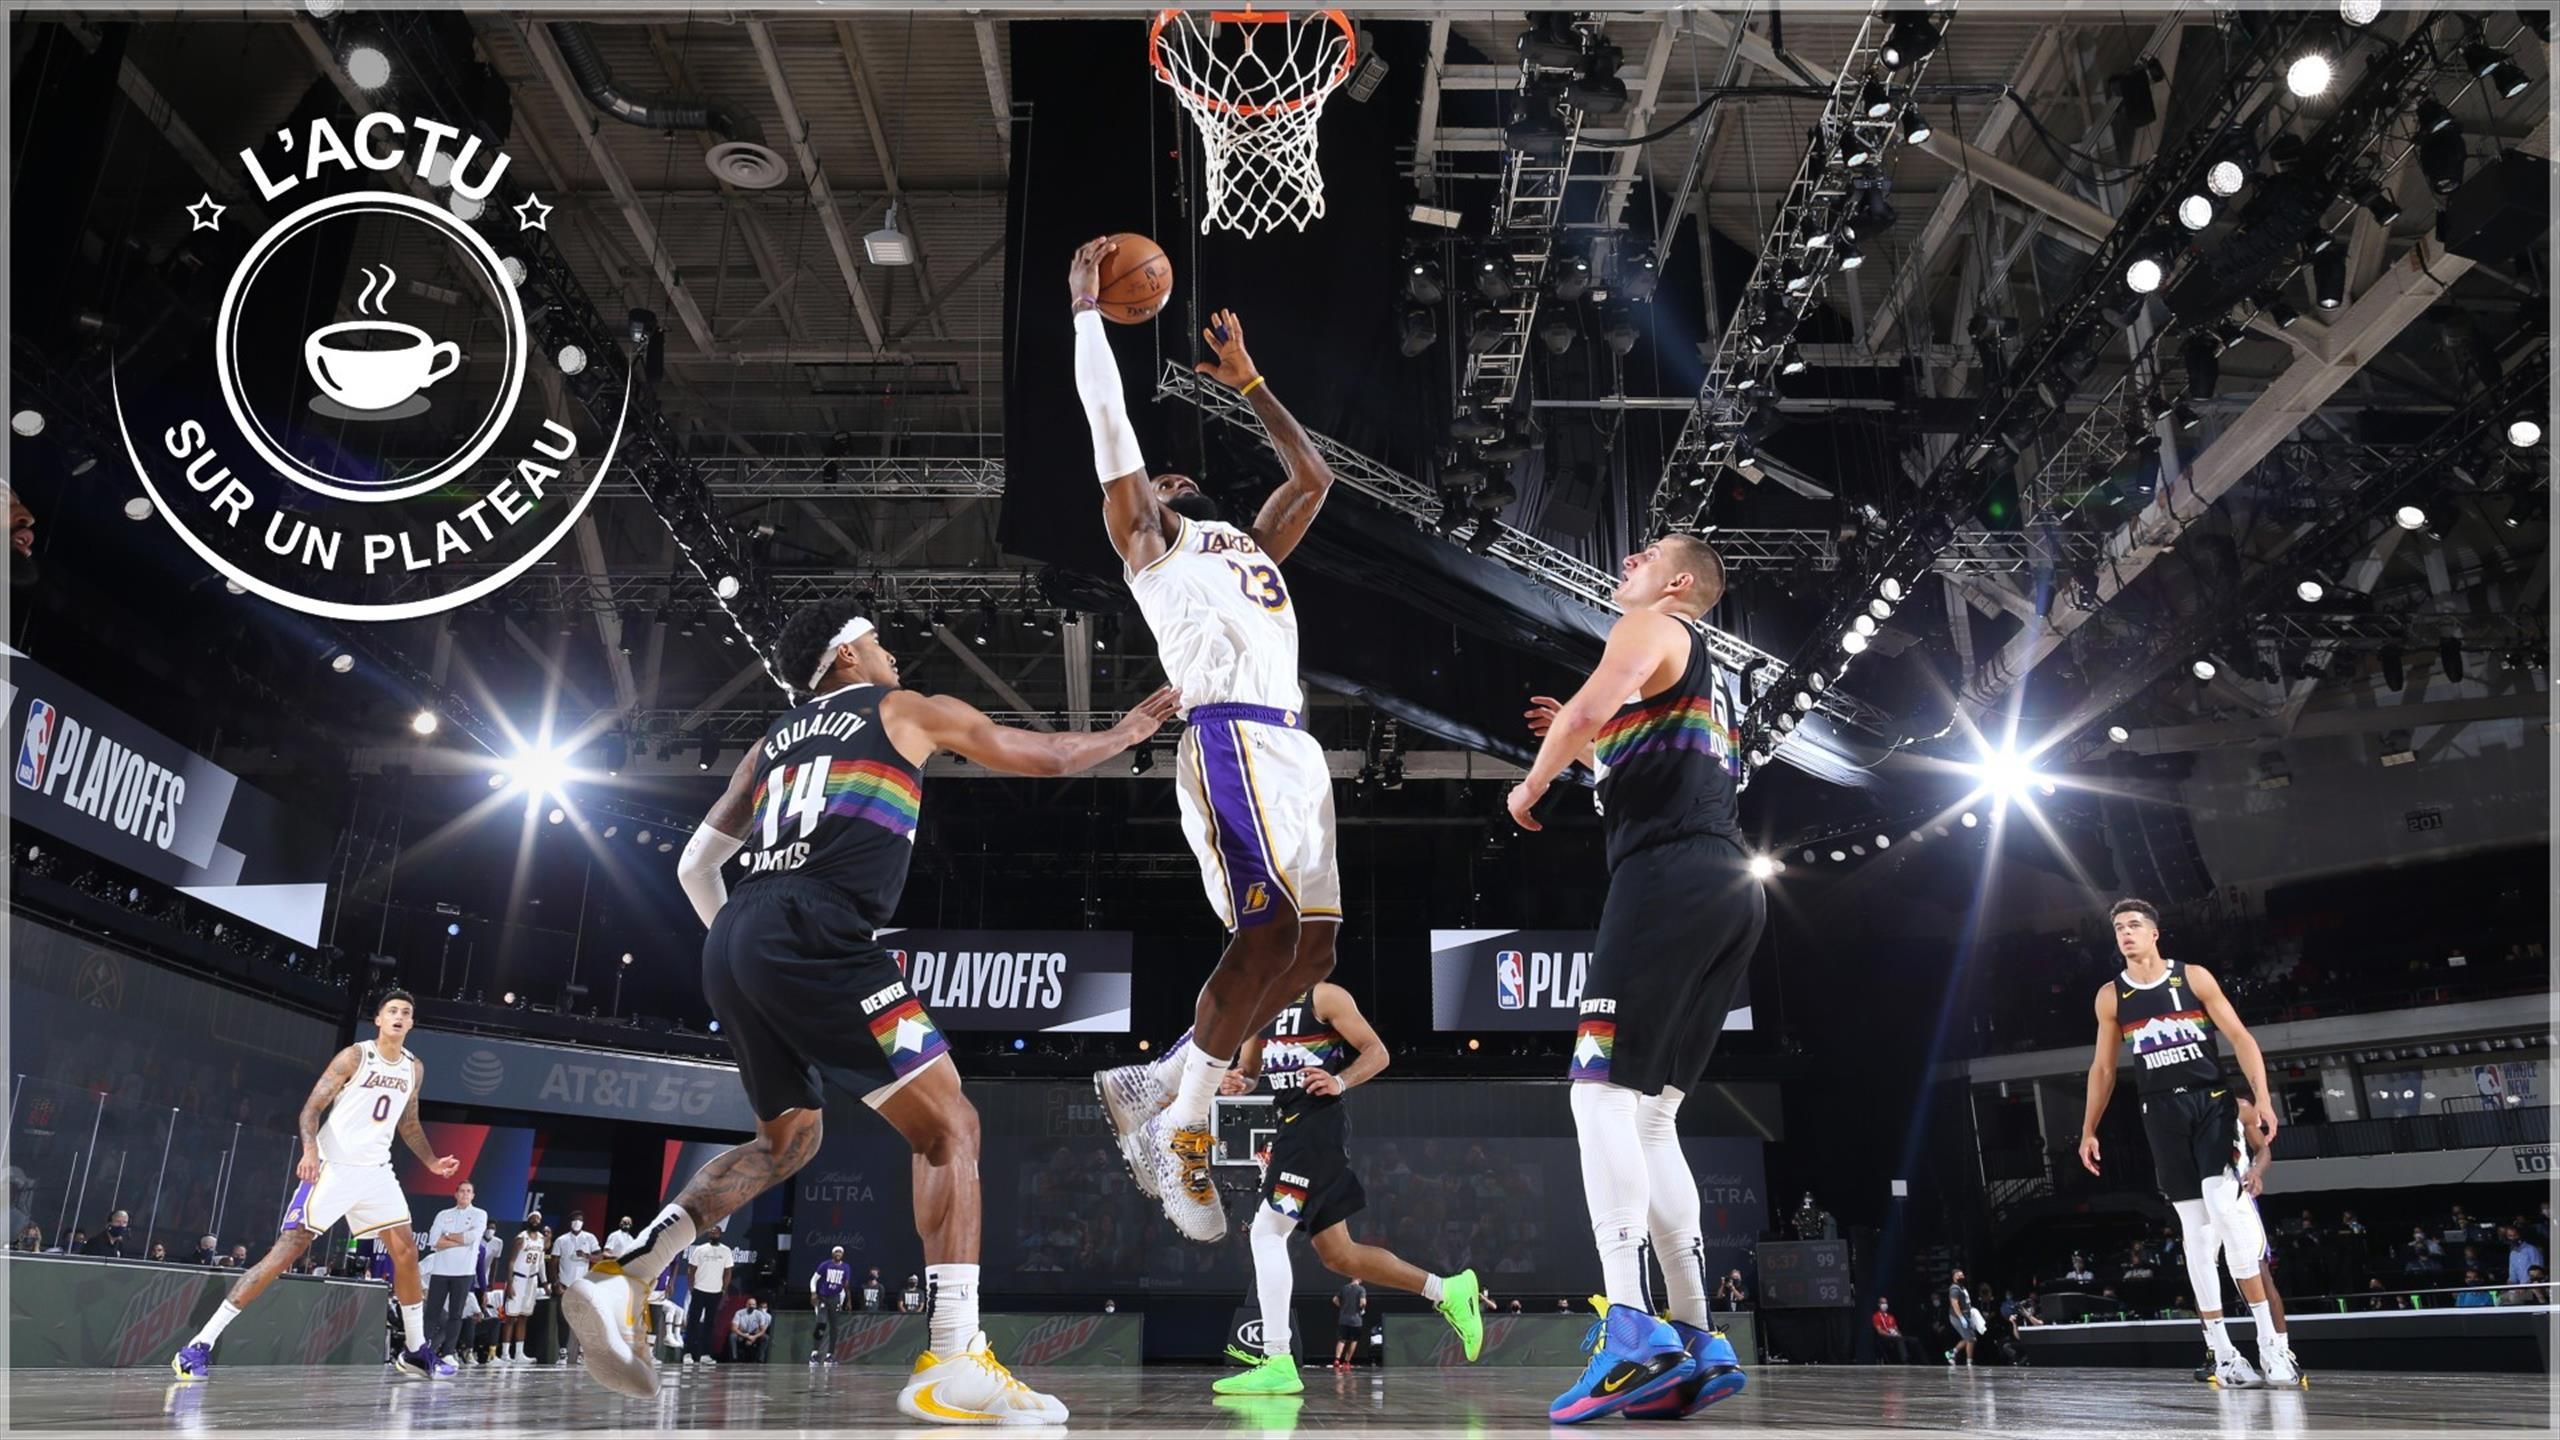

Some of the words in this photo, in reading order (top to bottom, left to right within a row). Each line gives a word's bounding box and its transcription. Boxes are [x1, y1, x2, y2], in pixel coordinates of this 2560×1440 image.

[1225, 559, 1289, 613] 23
[764, 711, 867, 760] EQUALITY
[42, 715, 186, 850] PLAYOFFS
[762, 755, 832, 850] 14
[2407, 814, 2441, 831] 201
[910, 951, 1067, 1010] PLAYOFFS
[1528, 952, 1594, 1008] PLA
[860, 980, 908, 1016] DENVER
[2168, 987, 2183, 1011] 1
[1274, 1007, 1302, 1036] 27
[360, 1070, 409, 1093] LAKERS
[538, 1063, 649, 1109] AT&T
[648, 1076, 717, 1116] 5G
[372, 1093, 391, 1121] 0
[805, 1186, 875, 1201] ULTRA
[1279, 1171, 1310, 1189] DENVER
[1703, 1188, 1757, 1204] LTRA
[1816, 1253, 1835, 1267] 99
[825, 1268, 844, 1285] VOTE
[1819, 1286, 1838, 1300] 93
